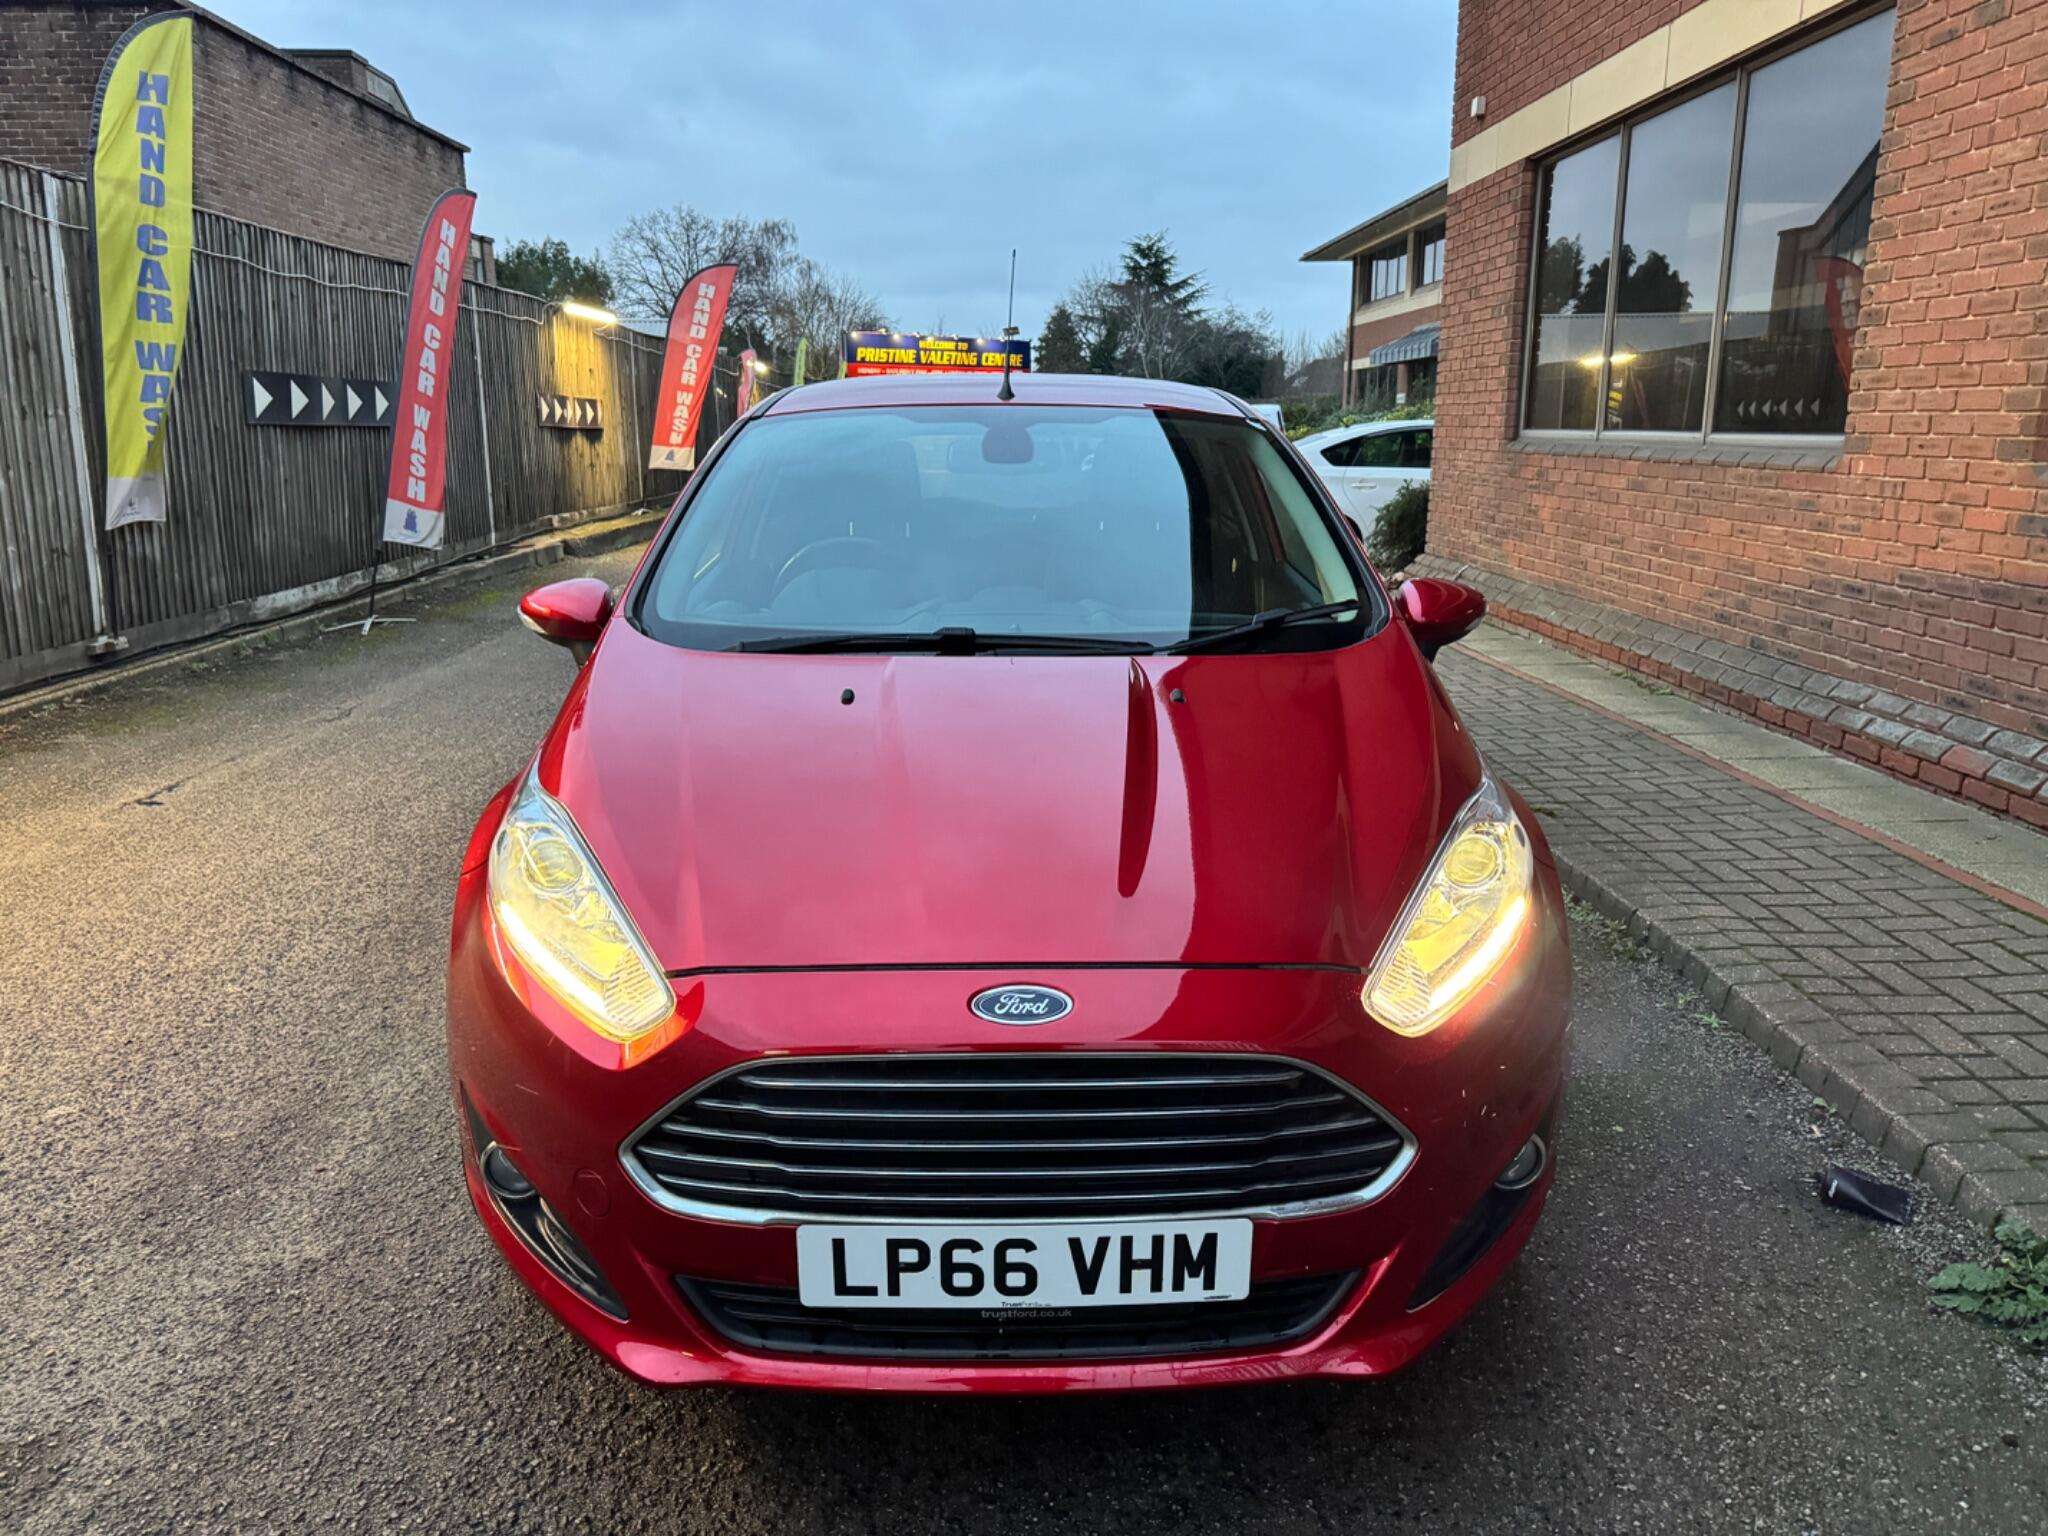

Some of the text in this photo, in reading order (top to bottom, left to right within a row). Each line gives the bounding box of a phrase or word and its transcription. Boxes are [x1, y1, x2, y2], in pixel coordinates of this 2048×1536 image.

[135, 71, 176, 450] HAND CAR WAS
[408, 219, 455, 501] HAND CAR WASH
[669, 284, 714, 444] HAND CAR WASH
[856, 347, 916, 364] PRISTINE
[920, 350, 978, 366] VALETING
[994, 993, 1049, 1014] Ford
[831, 1232, 1218, 1297] LP66 VHM
[981, 1308, 1072, 1318] trustford.co.uk
